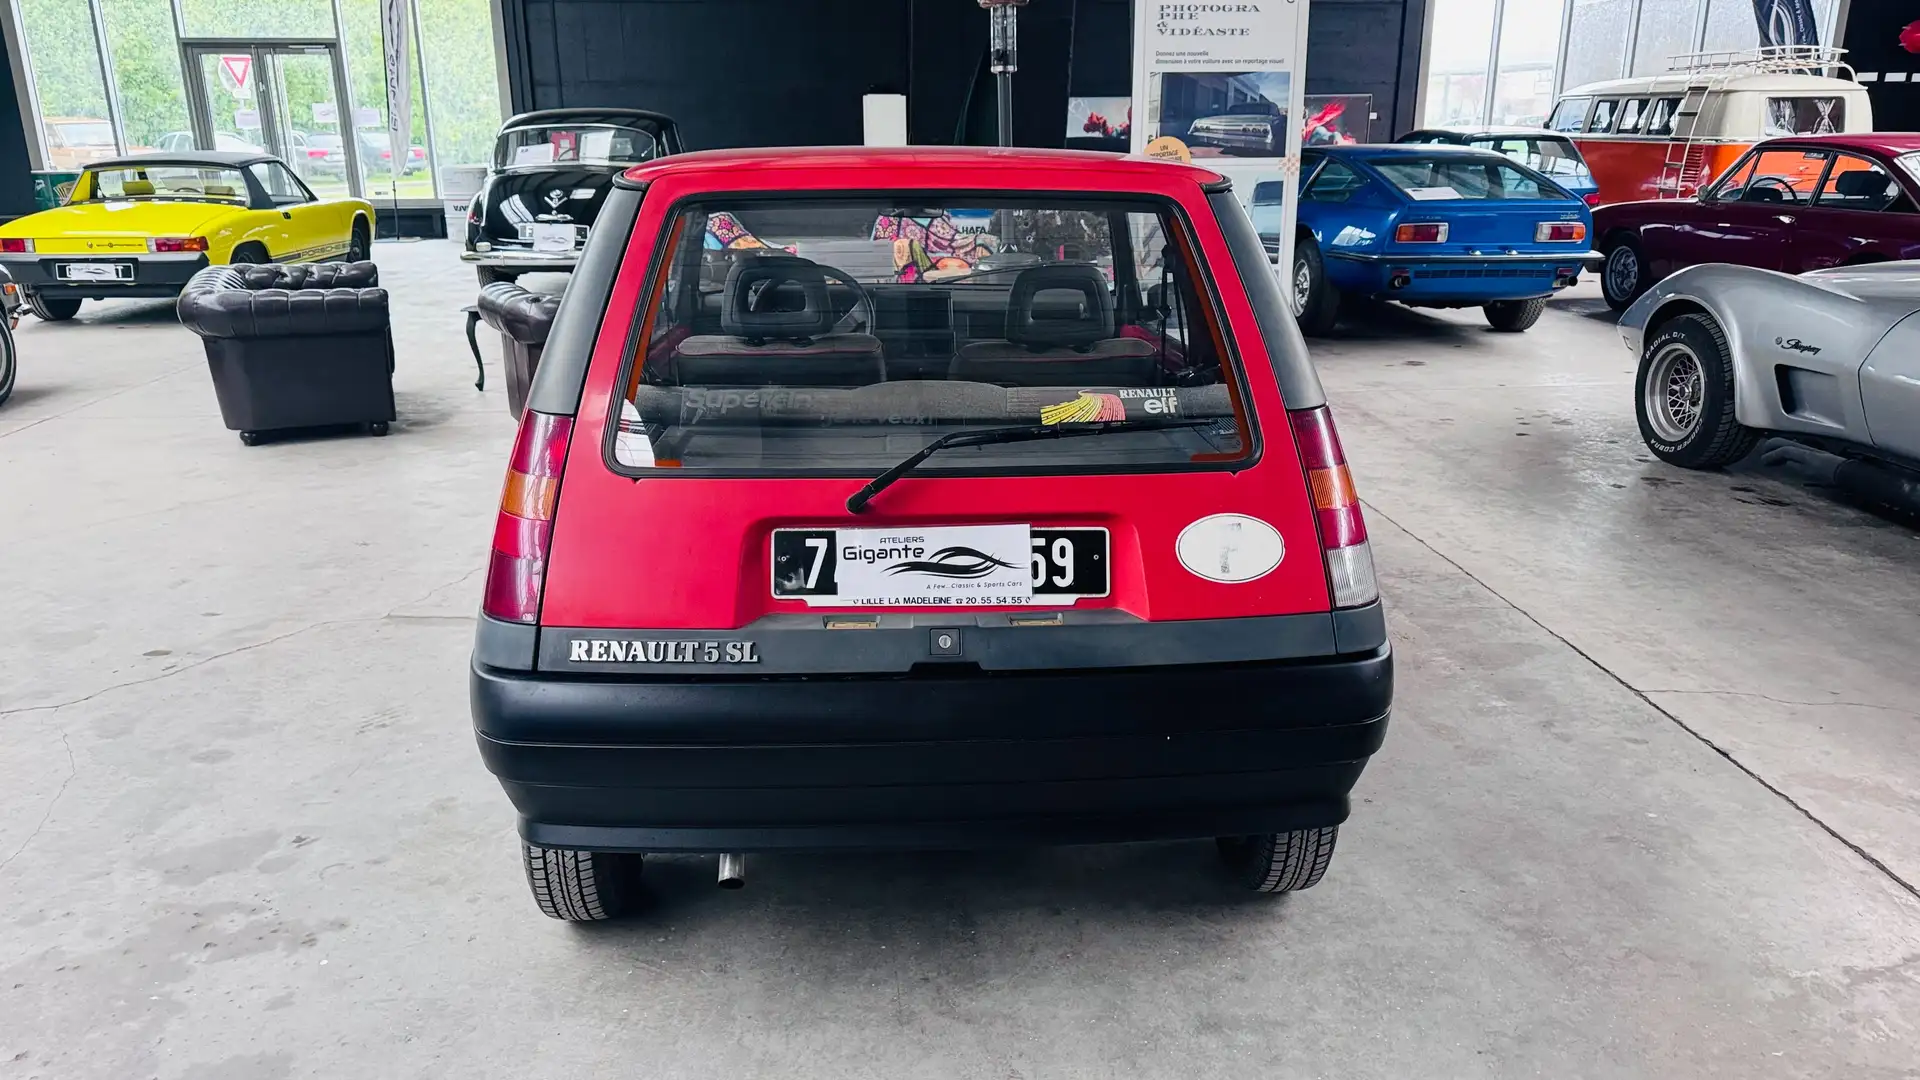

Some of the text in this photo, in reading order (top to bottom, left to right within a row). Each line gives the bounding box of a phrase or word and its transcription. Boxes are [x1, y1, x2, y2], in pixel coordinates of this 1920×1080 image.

[1159, 4, 1261, 13] PHOTOGRA
[1158, 12, 1199, 20] PHE
[1157, 26, 1250, 36] VIDÉASTE
[1645, 333, 1671, 360] RADIAL
[1118, 388, 1176, 399] RENAULT
[1143, 397, 1179, 414] elf
[1676, 418, 1703, 451] COOPER
[1650, 438, 1676, 452] COBRA
[879, 536, 925, 544] ATELIERS
[843, 544, 925, 564] Gigante
[805, 538, 838, 589] 7
[861, 597, 885, 605] LILLE
[903, 596, 952, 604] MADELEINE
[569, 640, 759, 663] RENAULT 5 SL
